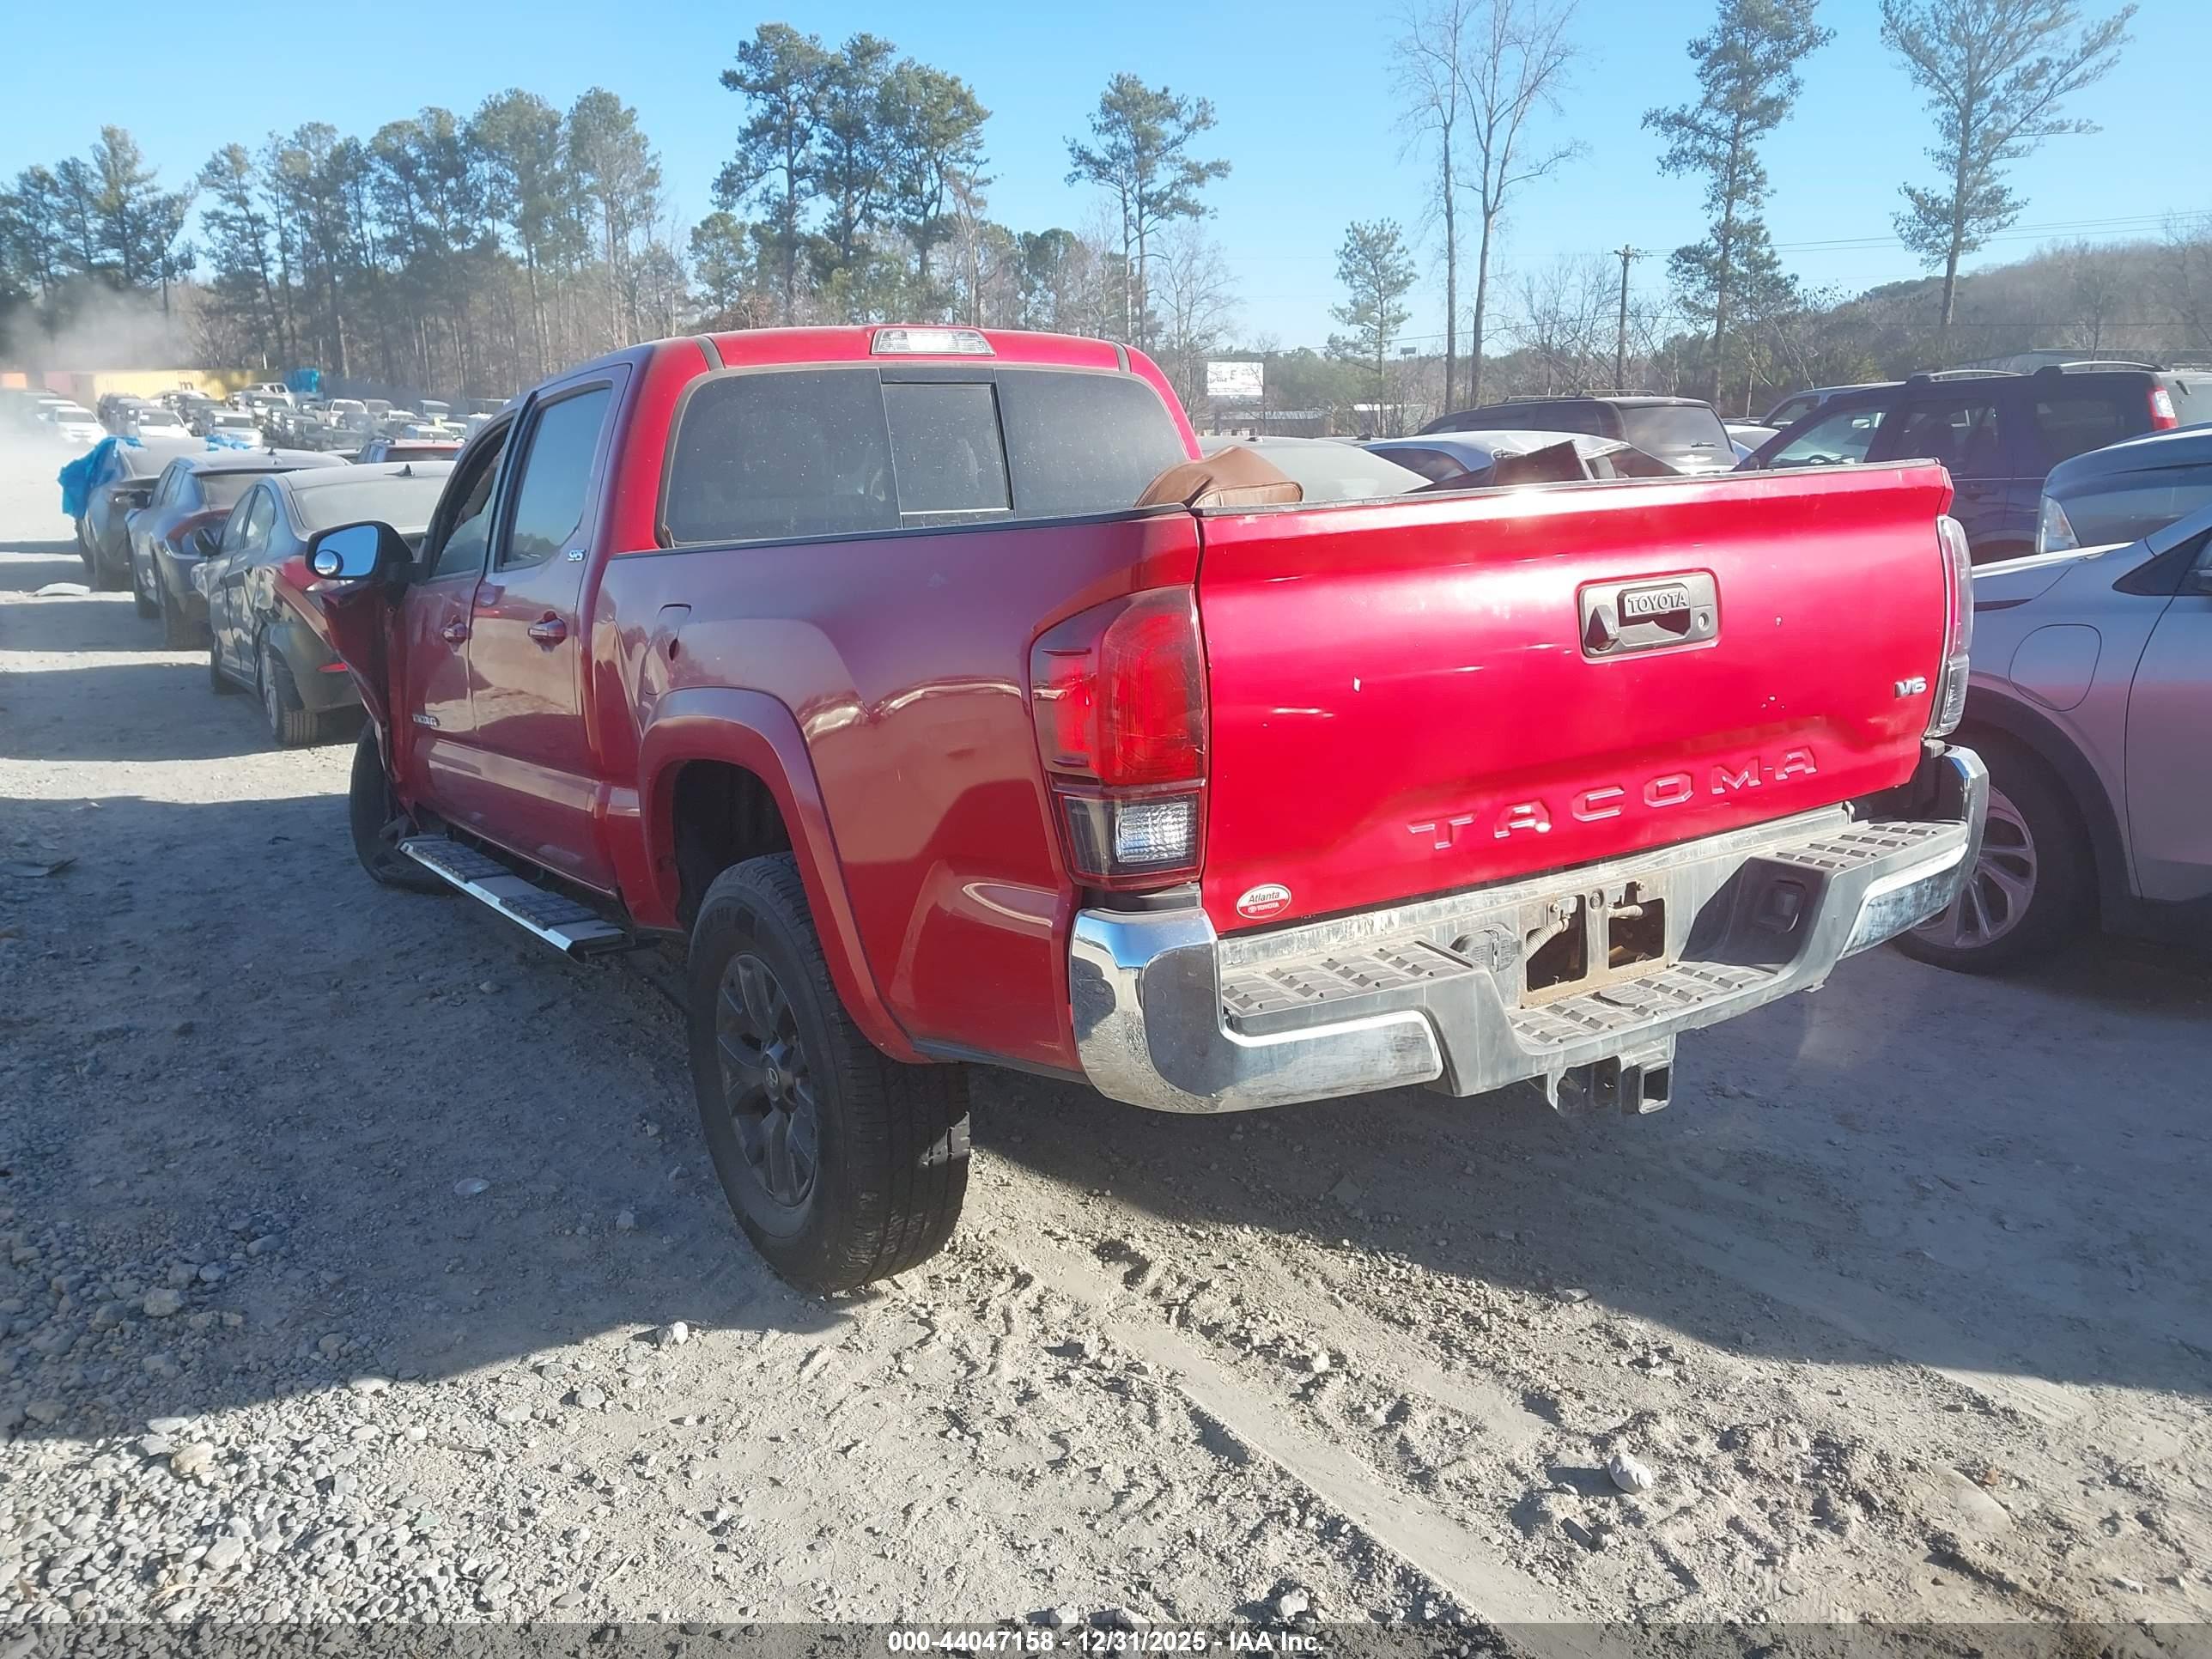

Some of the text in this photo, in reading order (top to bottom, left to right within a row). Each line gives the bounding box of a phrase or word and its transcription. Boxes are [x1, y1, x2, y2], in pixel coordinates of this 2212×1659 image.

[1627, 591, 1687, 613] TOYOTA
[1894, 676, 1927, 697] V6
[1407, 745, 1818, 850] TACOMA
[1249, 890, 1279, 904] Atlanta
